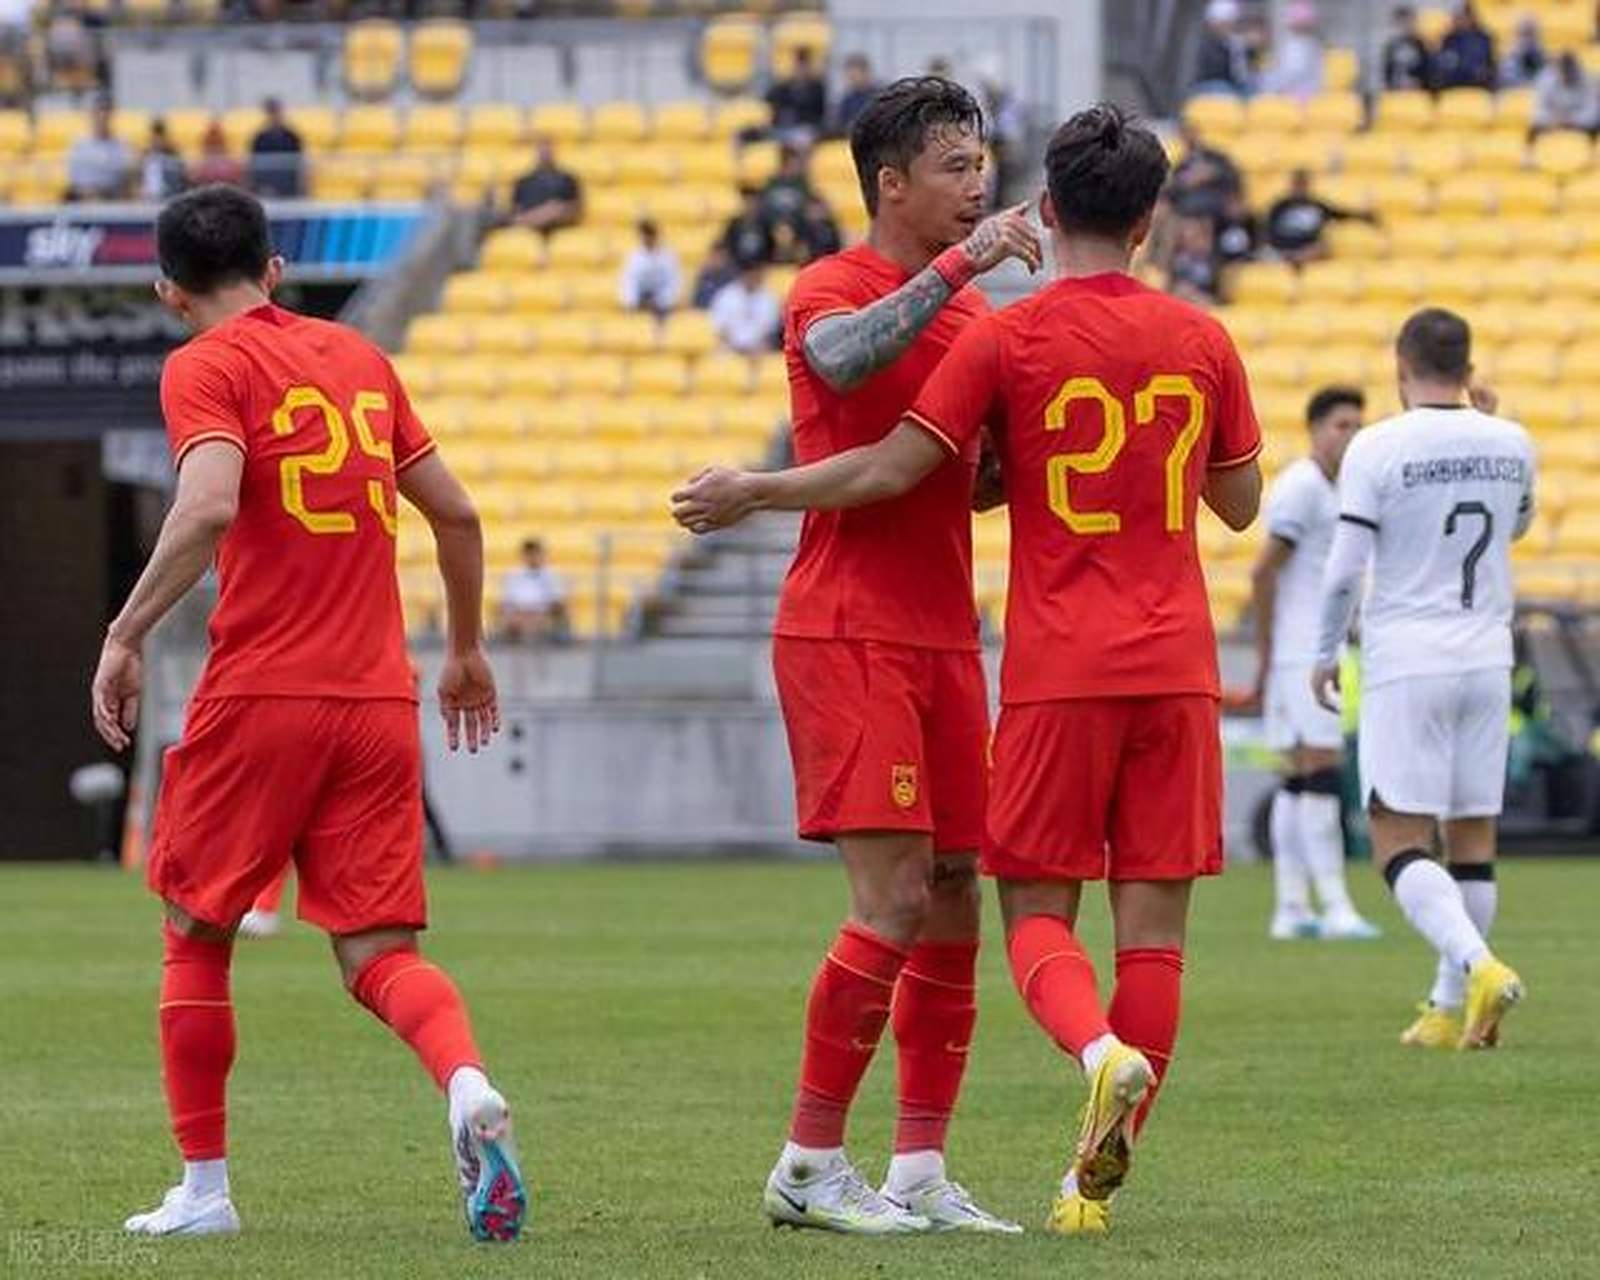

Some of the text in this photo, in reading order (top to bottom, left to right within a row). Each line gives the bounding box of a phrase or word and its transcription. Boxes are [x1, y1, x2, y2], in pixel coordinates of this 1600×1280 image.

[272, 387, 397, 534] 25
[1045, 375, 1205, 533] 27
[1445, 502, 1493, 610] 7
